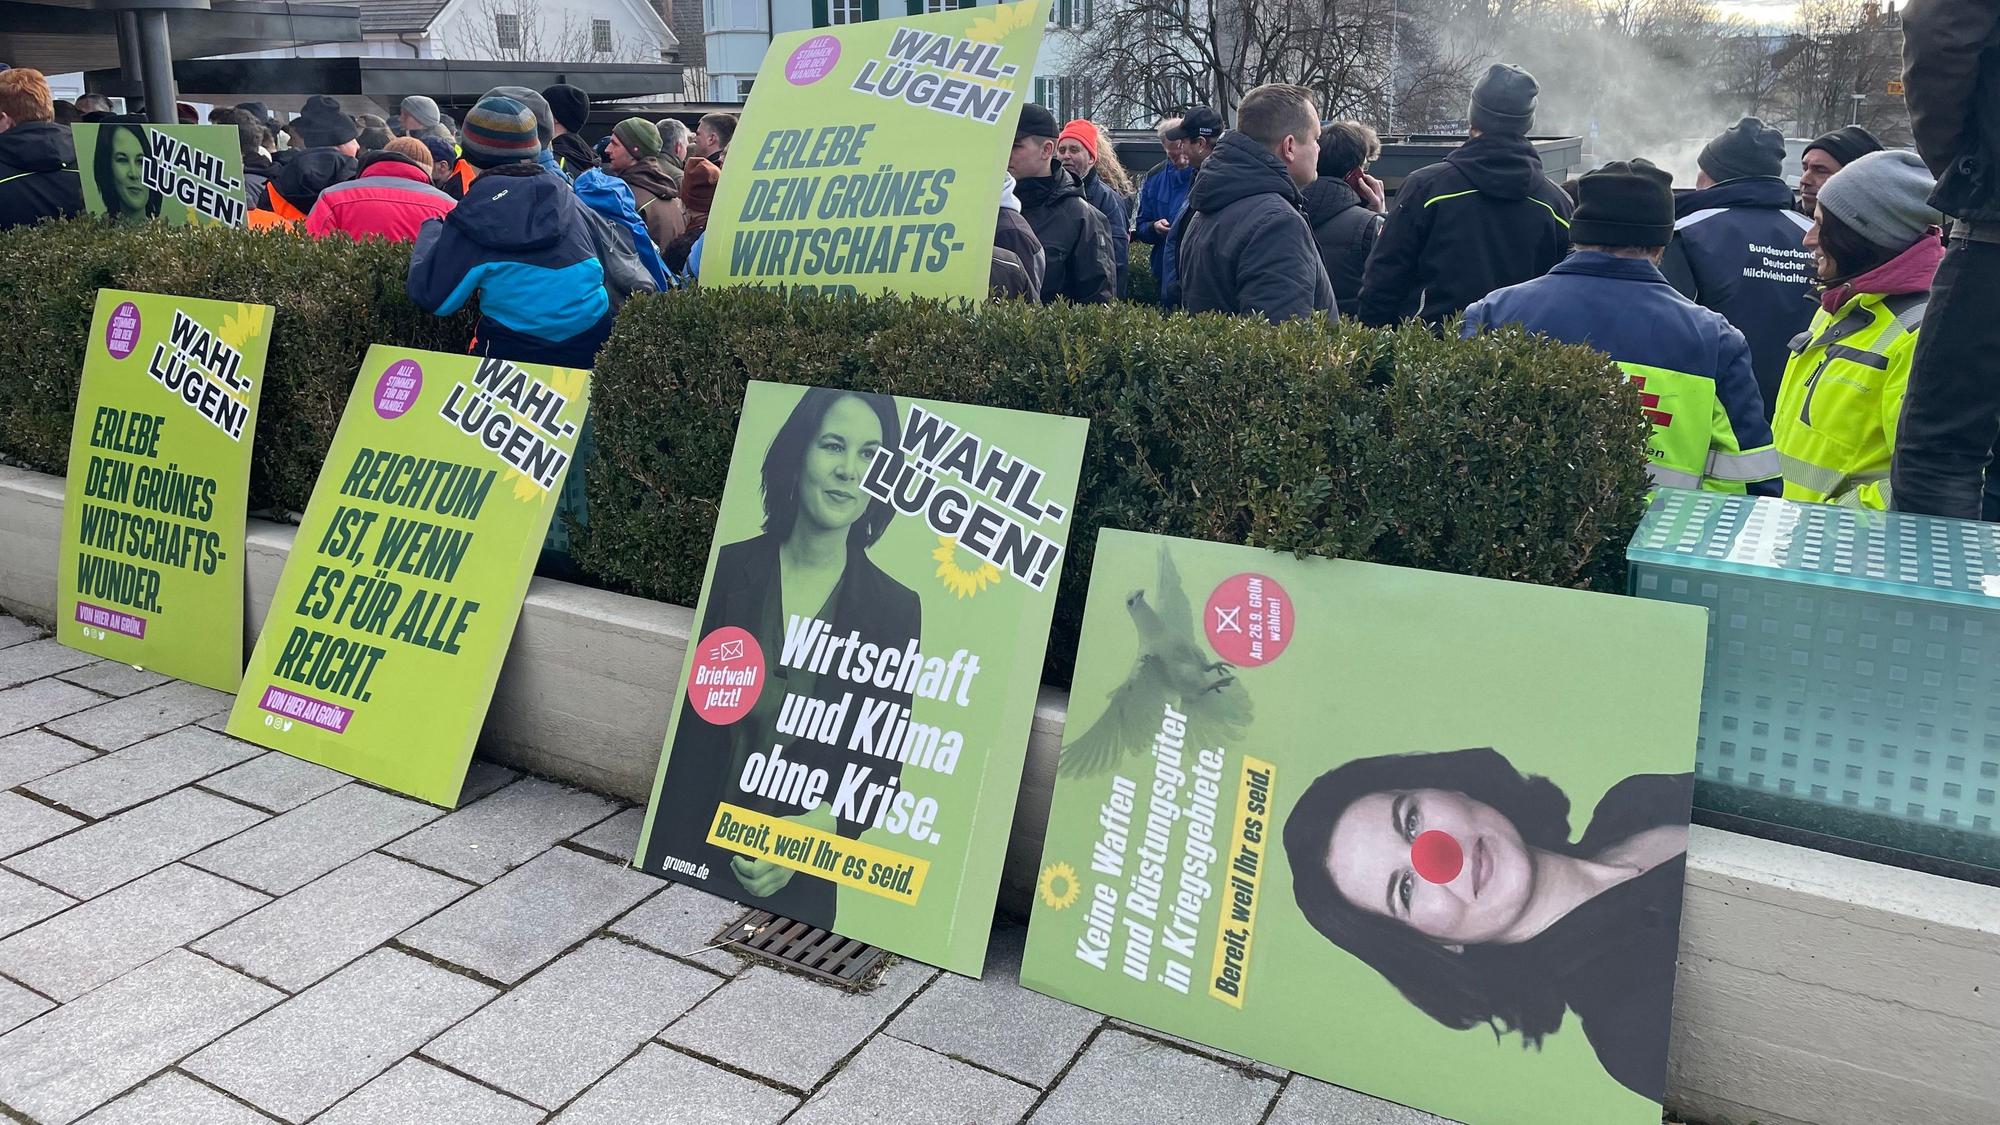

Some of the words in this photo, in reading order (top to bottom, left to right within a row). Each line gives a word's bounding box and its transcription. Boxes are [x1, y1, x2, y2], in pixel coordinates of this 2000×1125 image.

[796, 46, 834, 60] STIMMEN
[808, 38, 830, 48] ALLE
[887, 28, 1017, 80] WAHL-
[852, 60, 1013, 123] LÜGEN!
[151, 130, 240, 190] WAHL-
[752, 123, 876, 171] ERLEBE
[142, 159, 244, 226] LÜGEN!
[738, 176, 822, 222] DEIN
[816, 164, 956, 220] GRÜNES
[729, 222, 965, 277] WIRTSCHAFTS-
[1743, 268, 1808, 284] Milchviehhalter
[1748, 243, 1816, 259] Bundesverband
[1763, 257, 1806, 270] Deutscher
[120, 306, 134, 317] ALLE
[170, 311, 251, 391] WAHL-
[396, 365, 414, 377] ALLE
[149, 345, 249, 439] LÜGEN!
[386, 375, 416, 390] STIMMEN
[395, 388, 410, 401] DEN
[473, 358, 576, 437] WAHL-
[90, 406, 166, 458] ERLEBE
[441, 384, 568, 488] LÜGEN!
[84, 456, 134, 504] DEIN
[132, 462, 217, 522] GRÜNES
[339, 447, 498, 521] REICHTUM
[901, 407, 1065, 522] WAHL-
[80, 503, 226, 576] WIRTSCHAFTS-
[317, 505, 378, 568] IST,
[372, 516, 474, 584] WENN
[862, 450, 1060, 589] LÜGEN!
[77, 552, 162, 614] WUNDER.
[295, 564, 346, 620] ES
[332, 569, 403, 636] FÜR
[390, 588, 480, 656] ALLE
[1246, 578, 1263, 608] GRÜN
[80, 605, 94, 622] VON
[94, 609, 110, 627] HIER
[110, 614, 121, 630] AN
[120, 616, 141, 636] GRÜN.
[1248, 611, 1263, 640] 26.9.
[1266, 597, 1281, 642] wählen!
[272, 626, 388, 703] REICHT.
[695, 664, 758, 688] Briefwahl
[779, 614, 981, 708] Wirtschaft
[1248, 641, 1263, 660] Am
[266, 689, 288, 711] VON
[282, 694, 307, 718] HIER
[302, 701, 320, 722] AN
[316, 706, 346, 730] GRÜN.
[704, 686, 742, 711] jetzt!
[776, 692, 854, 747] und
[847, 696, 964, 776] Klima
[738, 743, 829, 811] ohne
[830, 762, 942, 846] Krise.
[1125, 702, 1188, 922] Rüstungsgüter
[1246, 768, 1272, 809] seid.
[714, 810, 770, 855] Bereit,
[773, 834, 816, 866] weil
[811, 842, 844, 873] Ihr
[842, 854, 866, 881] es
[867, 862, 914, 896] seid.
[1090, 774, 1138, 878] Waffen
[1160, 746, 1226, 960] Kriegsgebiete.
[1243, 816, 1264, 846] es
[662, 854, 710, 880] gruene.de
[1232, 844, 1260, 878] Ihr
[1075, 882, 1118, 972] Keine
[1231, 876, 1254, 924] weil
[1122, 917, 1154, 982] und
[1157, 958, 1193, 995] in
[1215, 928, 1250, 999] Bereit,
